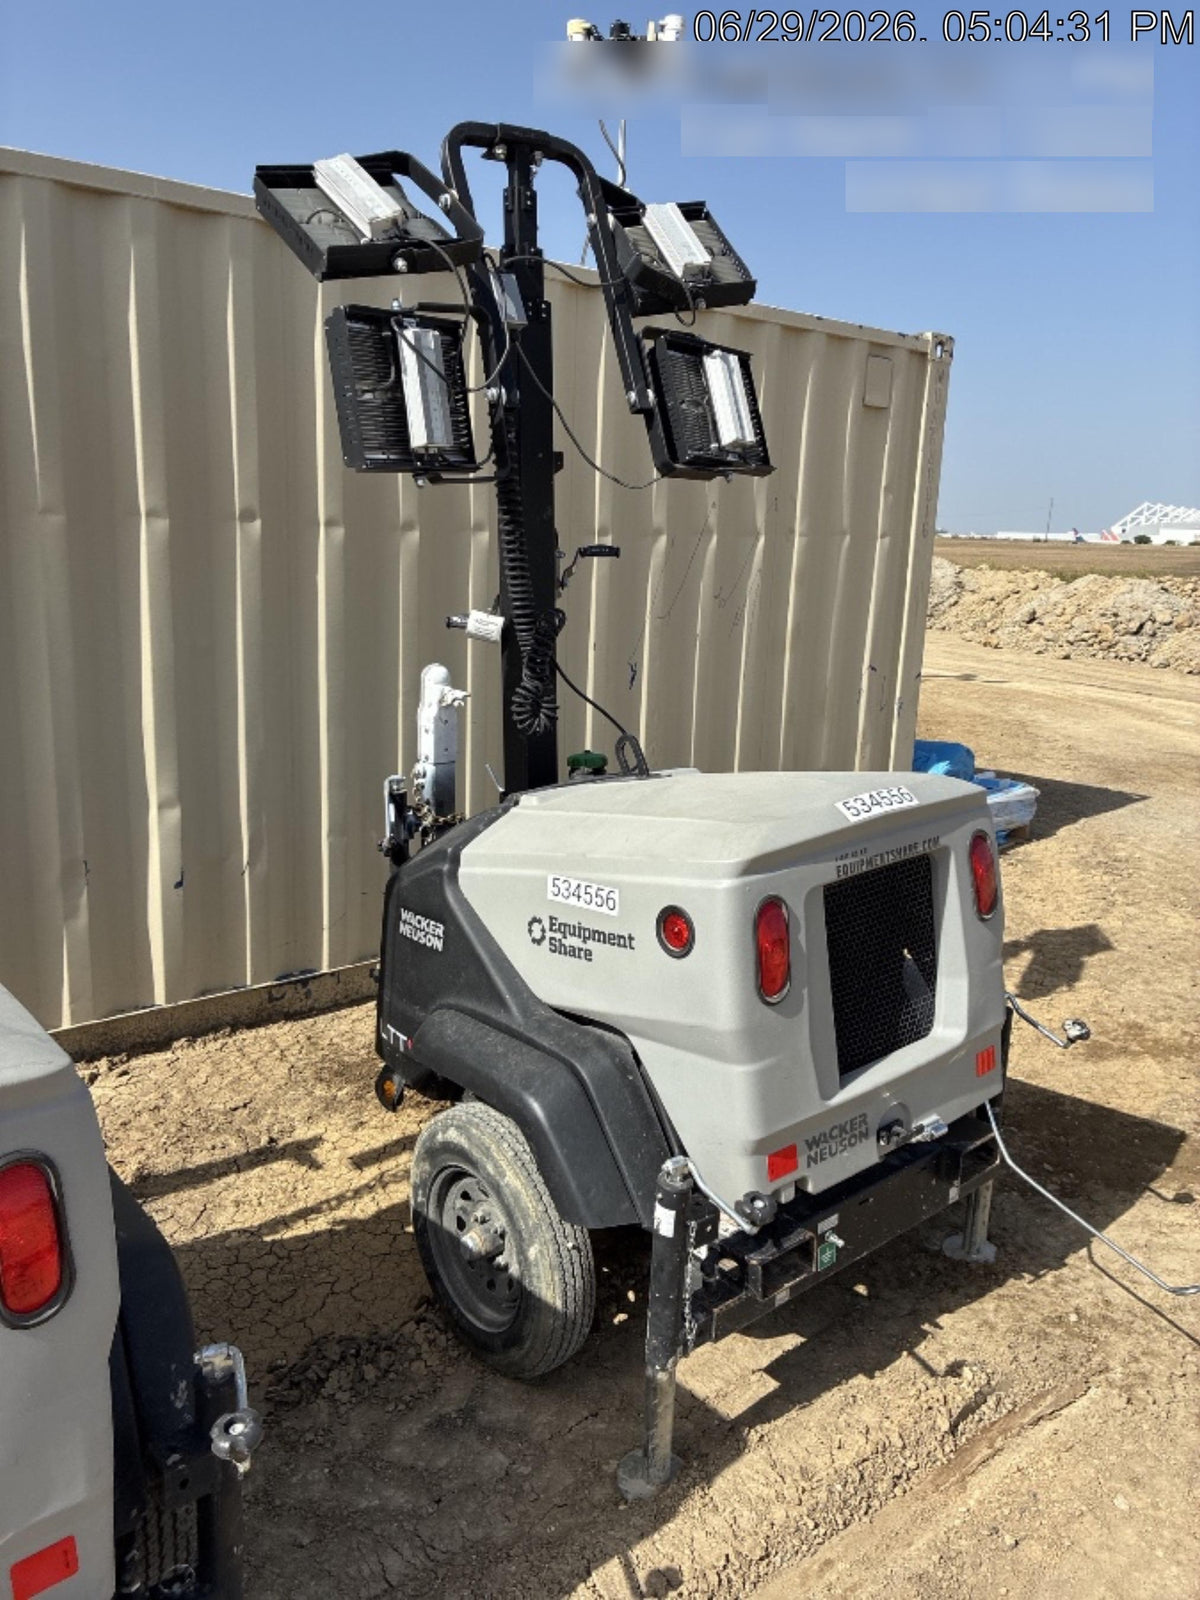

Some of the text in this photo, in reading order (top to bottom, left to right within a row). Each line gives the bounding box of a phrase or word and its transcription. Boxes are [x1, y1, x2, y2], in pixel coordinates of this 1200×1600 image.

[842, 787, 913, 816] 534556
[551, 877, 616, 911] 534556
[399, 921, 444, 951] NEUSON
[401, 908, 444, 937] WACKER
[548, 915, 636, 950] Equipment
[548, 936, 593, 962] Share
[804, 1113, 868, 1152] WACKER
[806, 1127, 869, 1169] NEUSON
